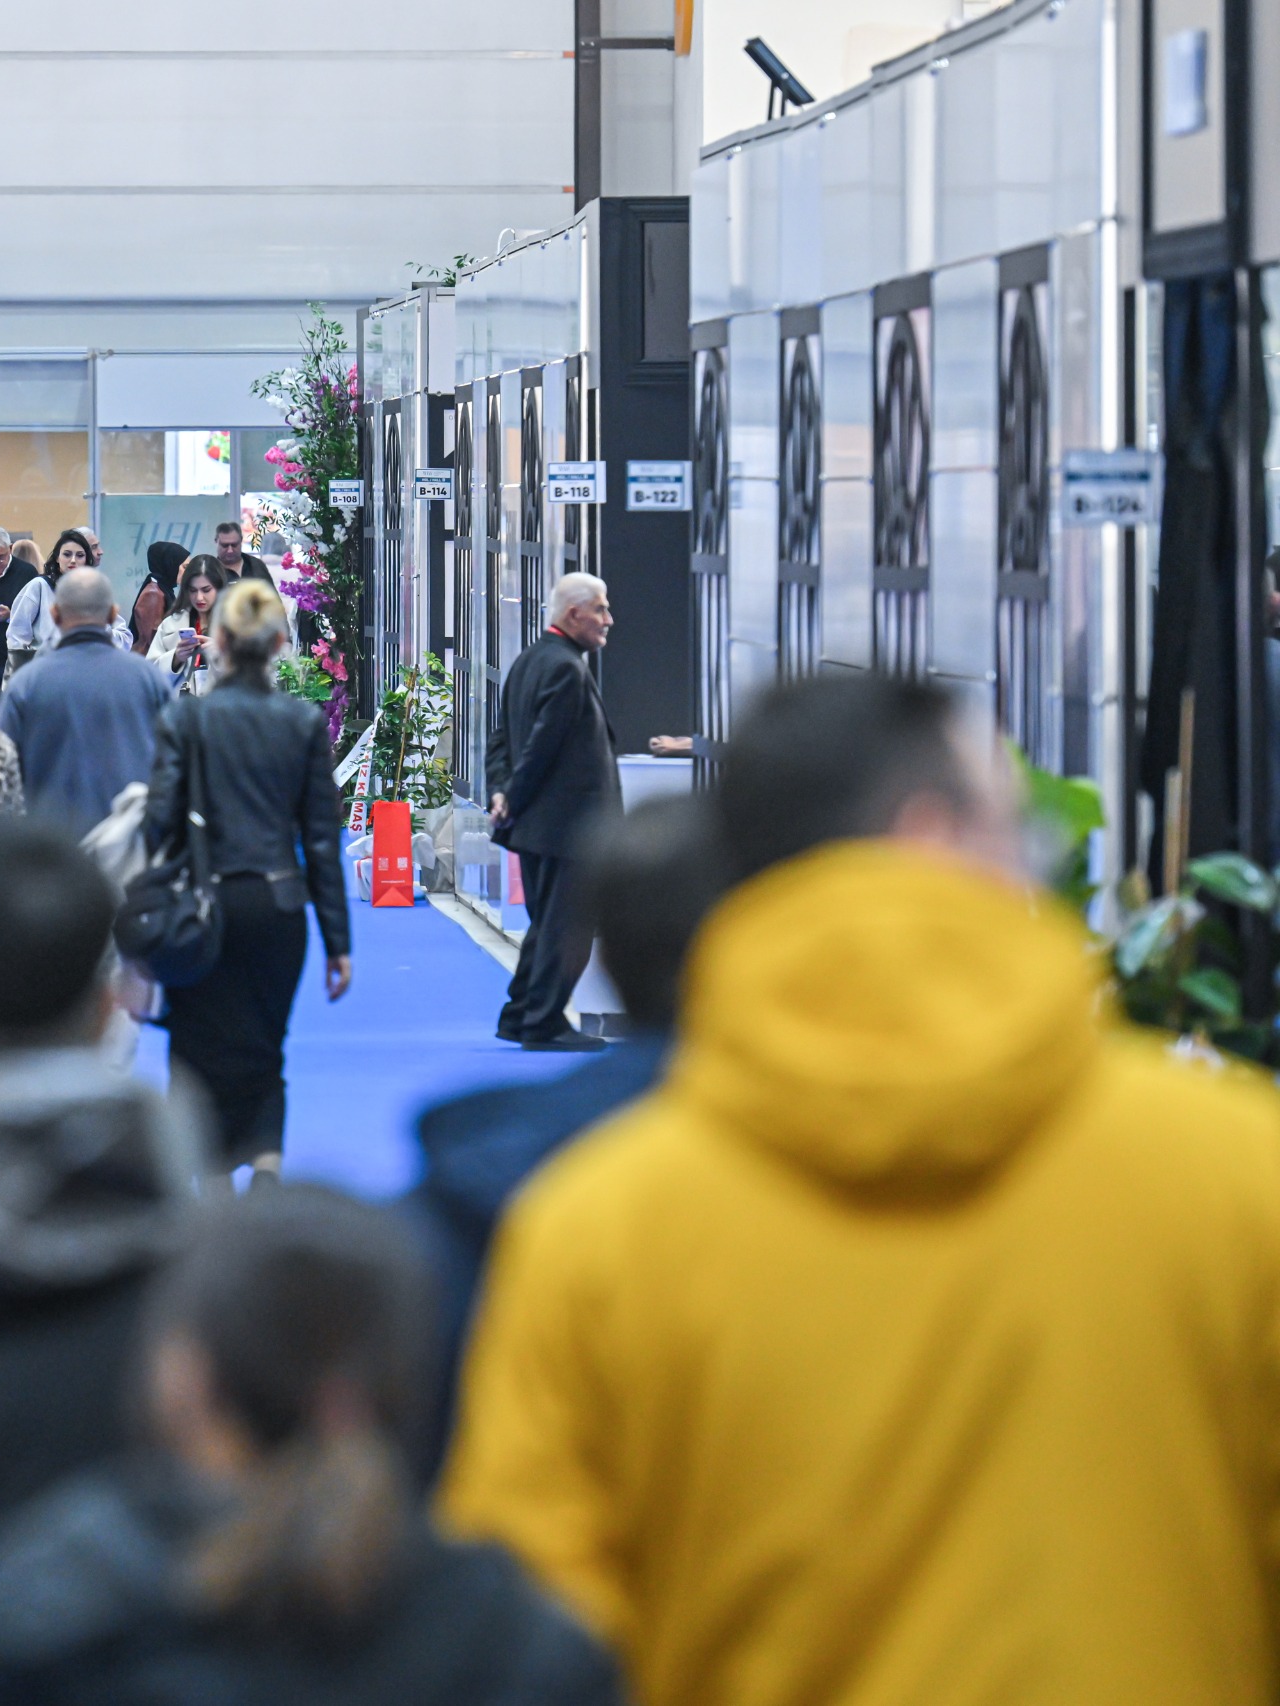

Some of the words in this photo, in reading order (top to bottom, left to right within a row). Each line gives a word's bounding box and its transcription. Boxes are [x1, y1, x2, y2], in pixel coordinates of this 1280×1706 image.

[420, 487, 447, 496] B-114
[554, 487, 590, 498] B-118
[635, 490, 678, 503] B-122
